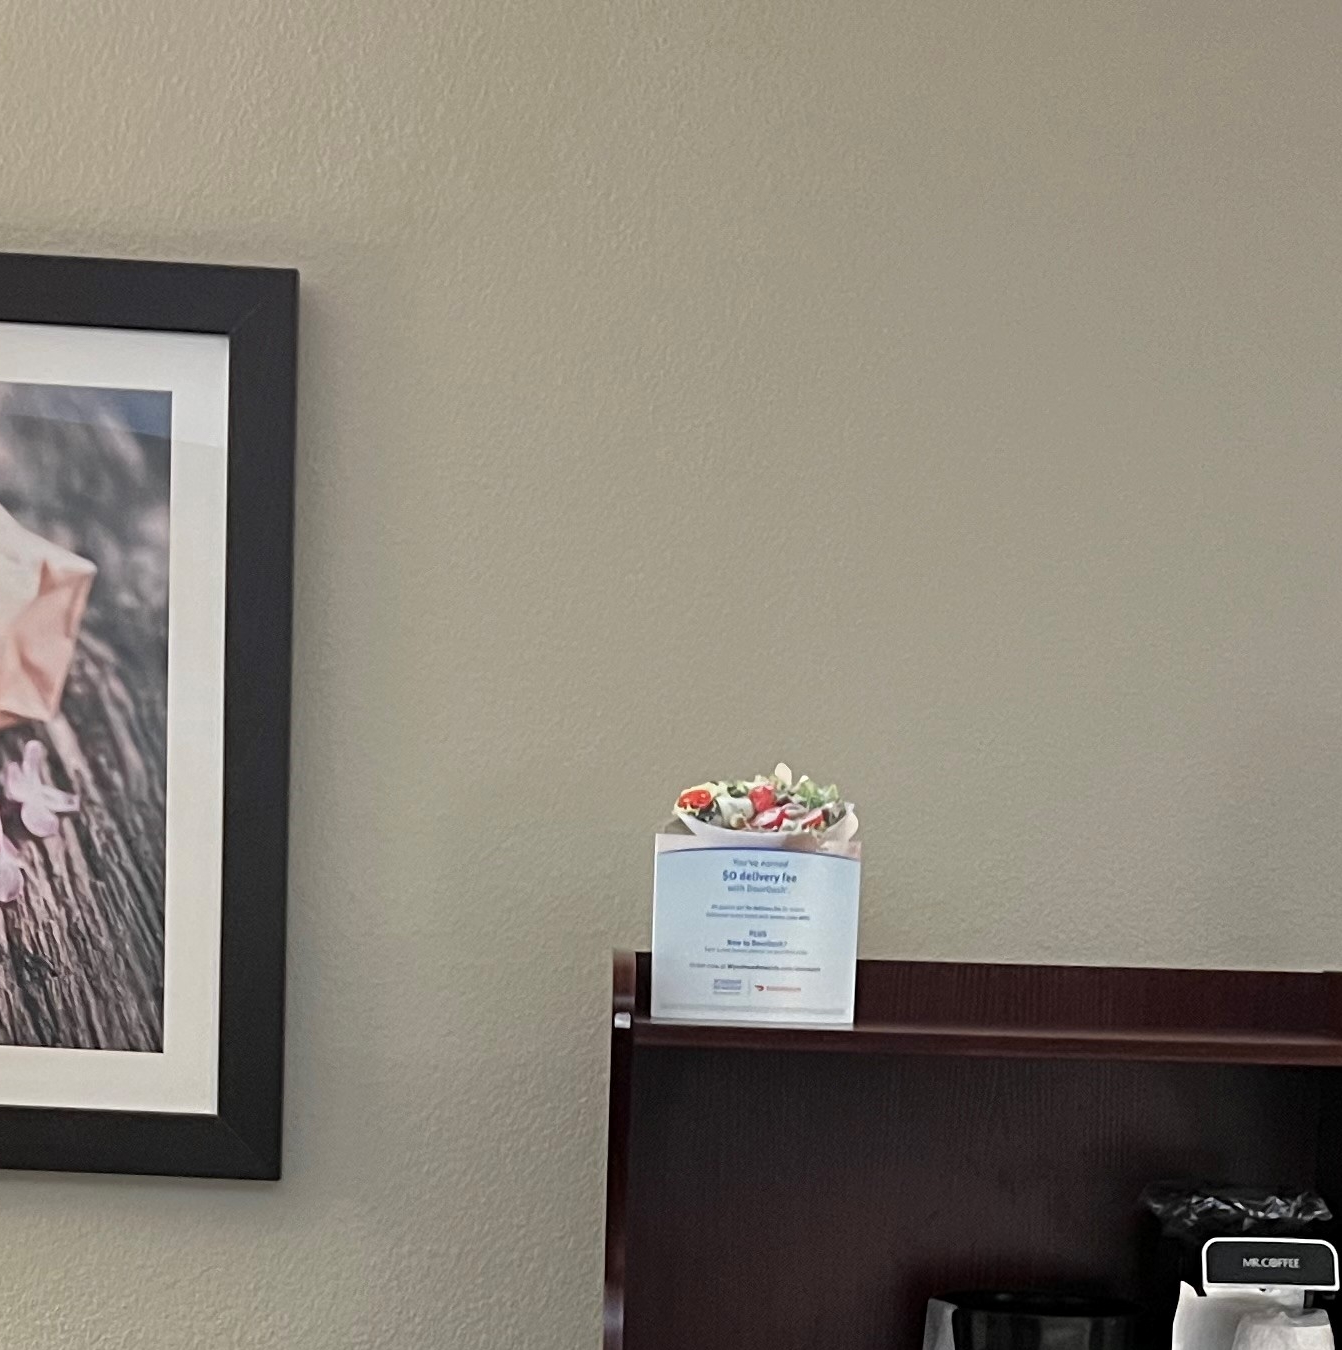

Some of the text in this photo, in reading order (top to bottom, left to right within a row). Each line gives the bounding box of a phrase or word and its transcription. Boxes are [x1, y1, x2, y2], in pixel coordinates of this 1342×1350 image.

[722, 869, 797, 884] $0 delivery fee
